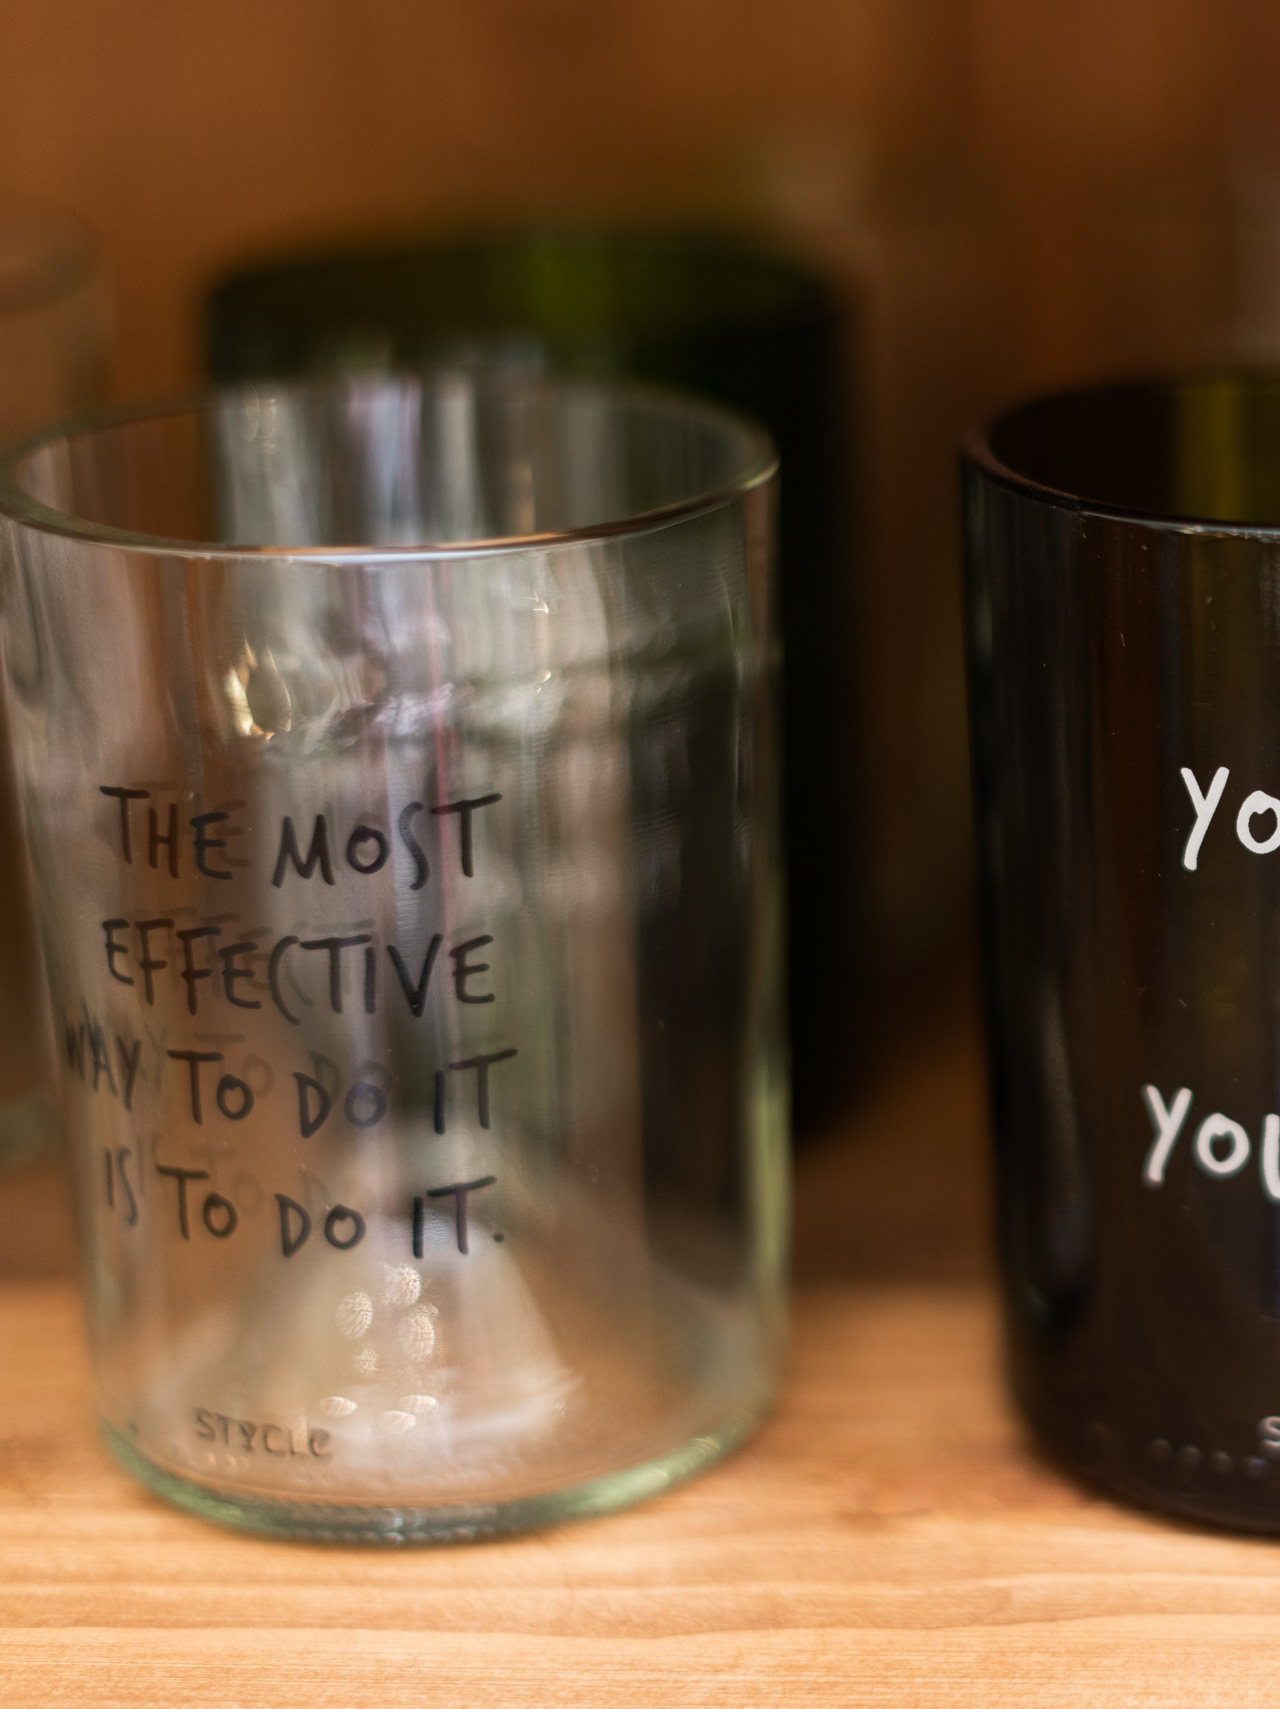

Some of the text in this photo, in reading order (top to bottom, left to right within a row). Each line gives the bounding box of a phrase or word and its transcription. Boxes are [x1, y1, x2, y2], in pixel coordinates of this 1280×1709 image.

[100, 785, 503, 890] THE MOST
[102, 918, 496, 1026] EFFECTIVE
[63, 1003, 518, 1139] WAY TO DO IT
[103, 1148, 505, 1260] IS TO DO IT.
